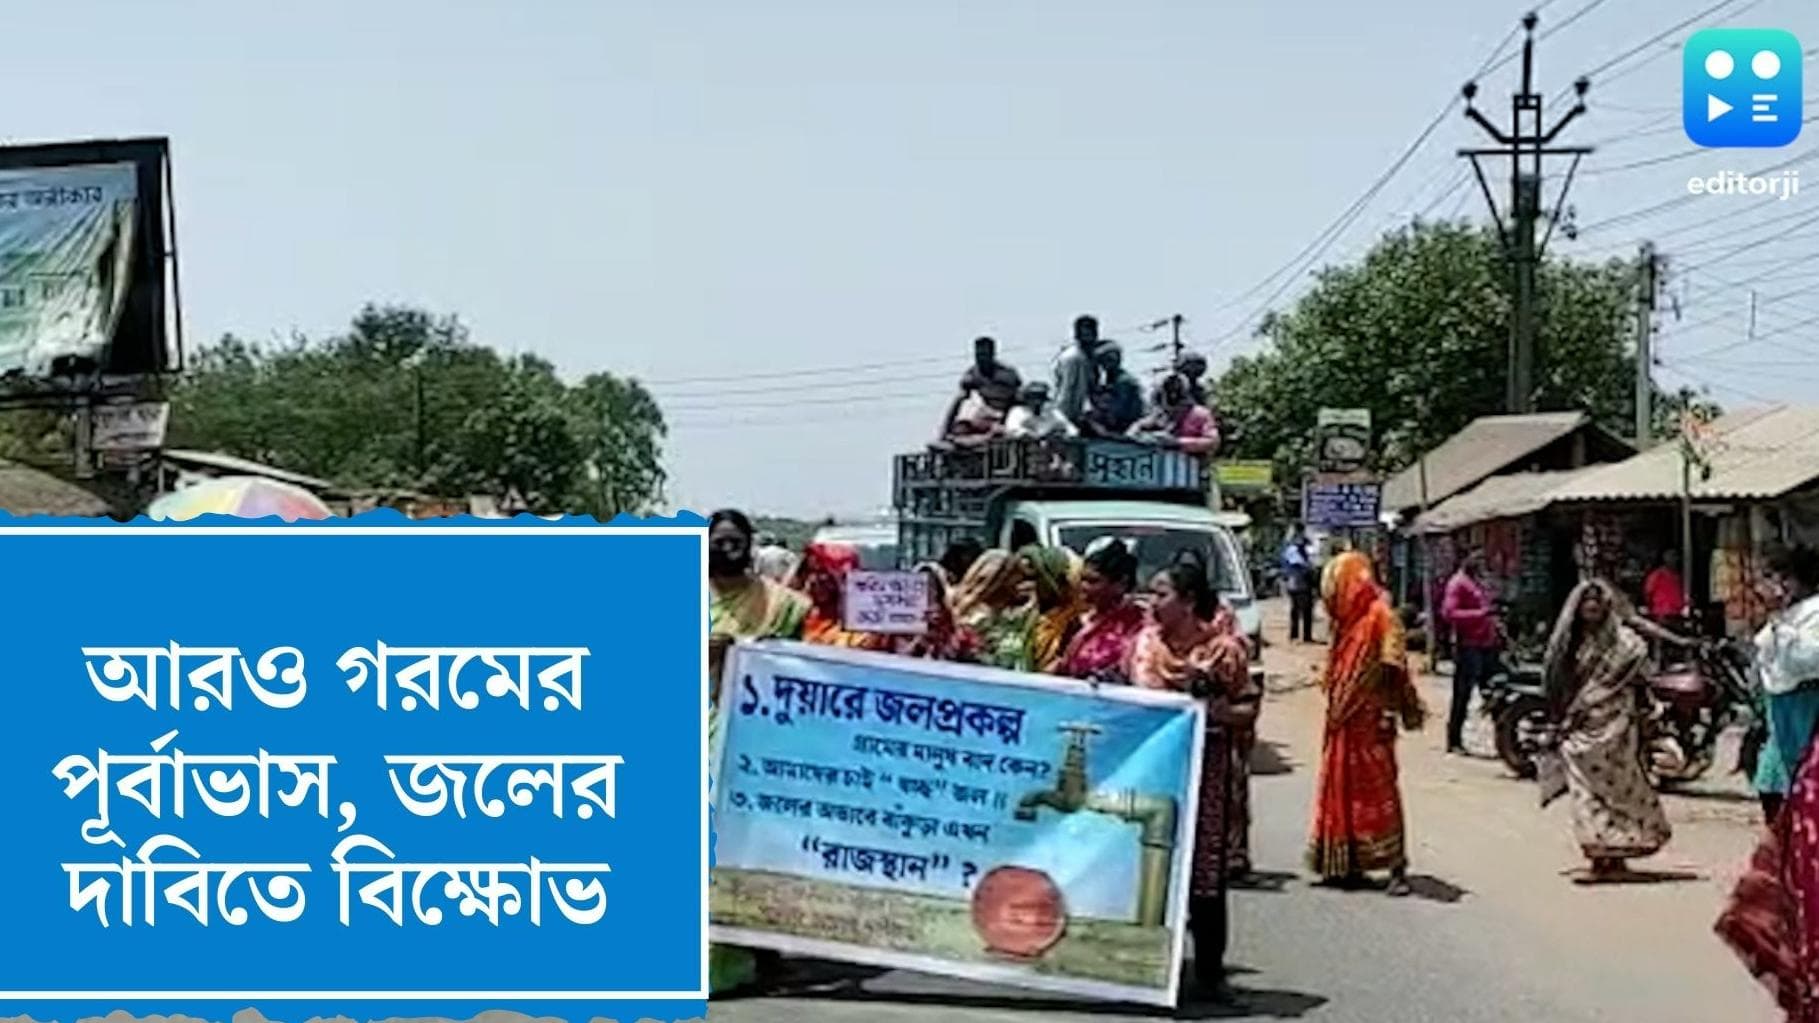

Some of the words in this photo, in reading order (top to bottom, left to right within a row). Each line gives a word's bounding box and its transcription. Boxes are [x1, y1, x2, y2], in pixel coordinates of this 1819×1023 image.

[874, 690, 1025, 744] জলপ্রকল্প
[853, 733, 908, 759] গ্রামের
[912, 742, 956, 771] মানুষ
[761, 758, 838, 786] আমাদের
[842, 765, 875, 790] চাই
[952, 782, 990, 807] জল
[756, 793, 812, 819] জলের
[815, 801, 877, 827] অভাবে
[881, 803, 940, 839] বাঁকুড়া
[943, 819, 991, 844] এখন
